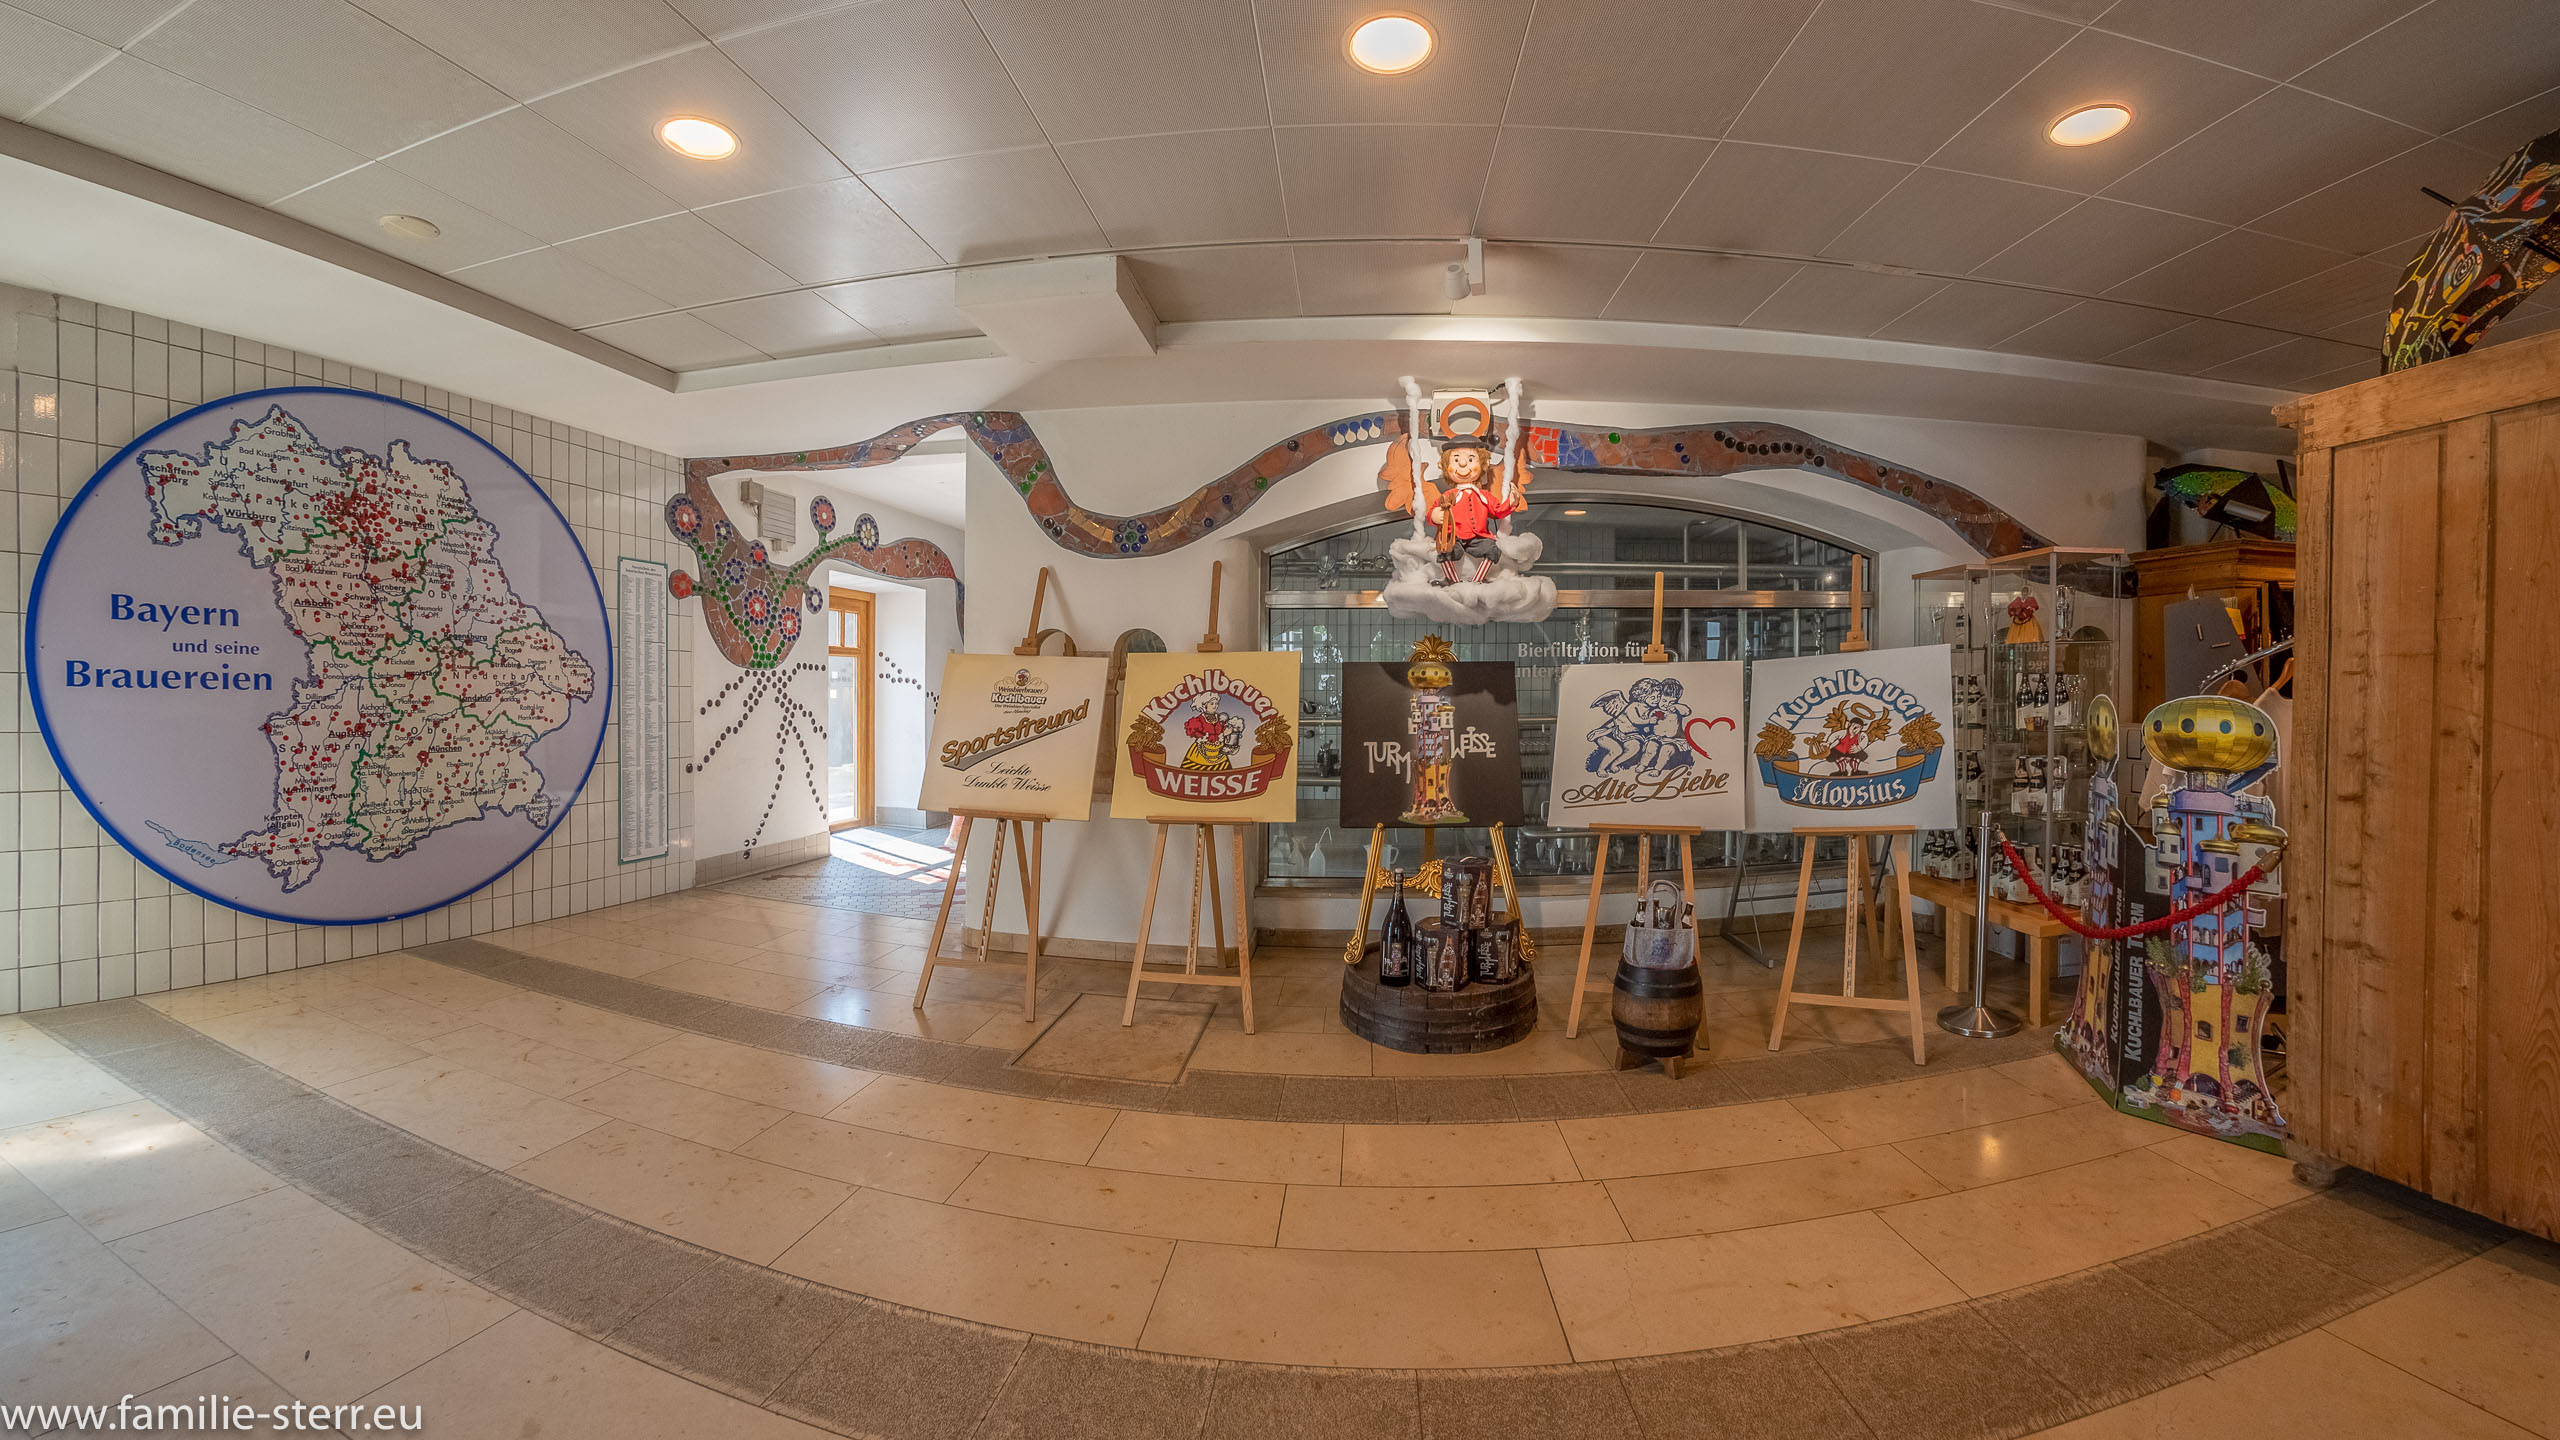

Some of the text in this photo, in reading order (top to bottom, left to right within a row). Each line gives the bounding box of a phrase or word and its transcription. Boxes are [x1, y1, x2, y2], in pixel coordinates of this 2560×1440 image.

[110, 593, 240, 632] Bayern
[172, 639, 260, 655] und seine
[1518, 642, 1648, 658] Bierfiltration für
[65, 659, 273, 691] Brauereien
[991, 692, 1047, 705] Kuchlbauer
[1142, 668, 1279, 724] Kuchlbauer
[1769, 668, 1926, 730] Kuchlbauer
[940, 698, 1090, 766] Sportsfreund
[428, 745, 463, 754] München
[1363, 741, 1412, 784] TURM
[963, 774, 1052, 792] Dunkle Weisse
[985, 761, 1032, 777] Leichte
[1155, 767, 1263, 797] WEISSE
[1562, 764, 1730, 804] Alte Liebe
[1791, 776, 1906, 810] Aloysius
[264, 813, 303, 822] Kempten
[172, 839, 216, 864] Bodensee
[2124, 956, 2143, 1062] KUCHLBAUER
